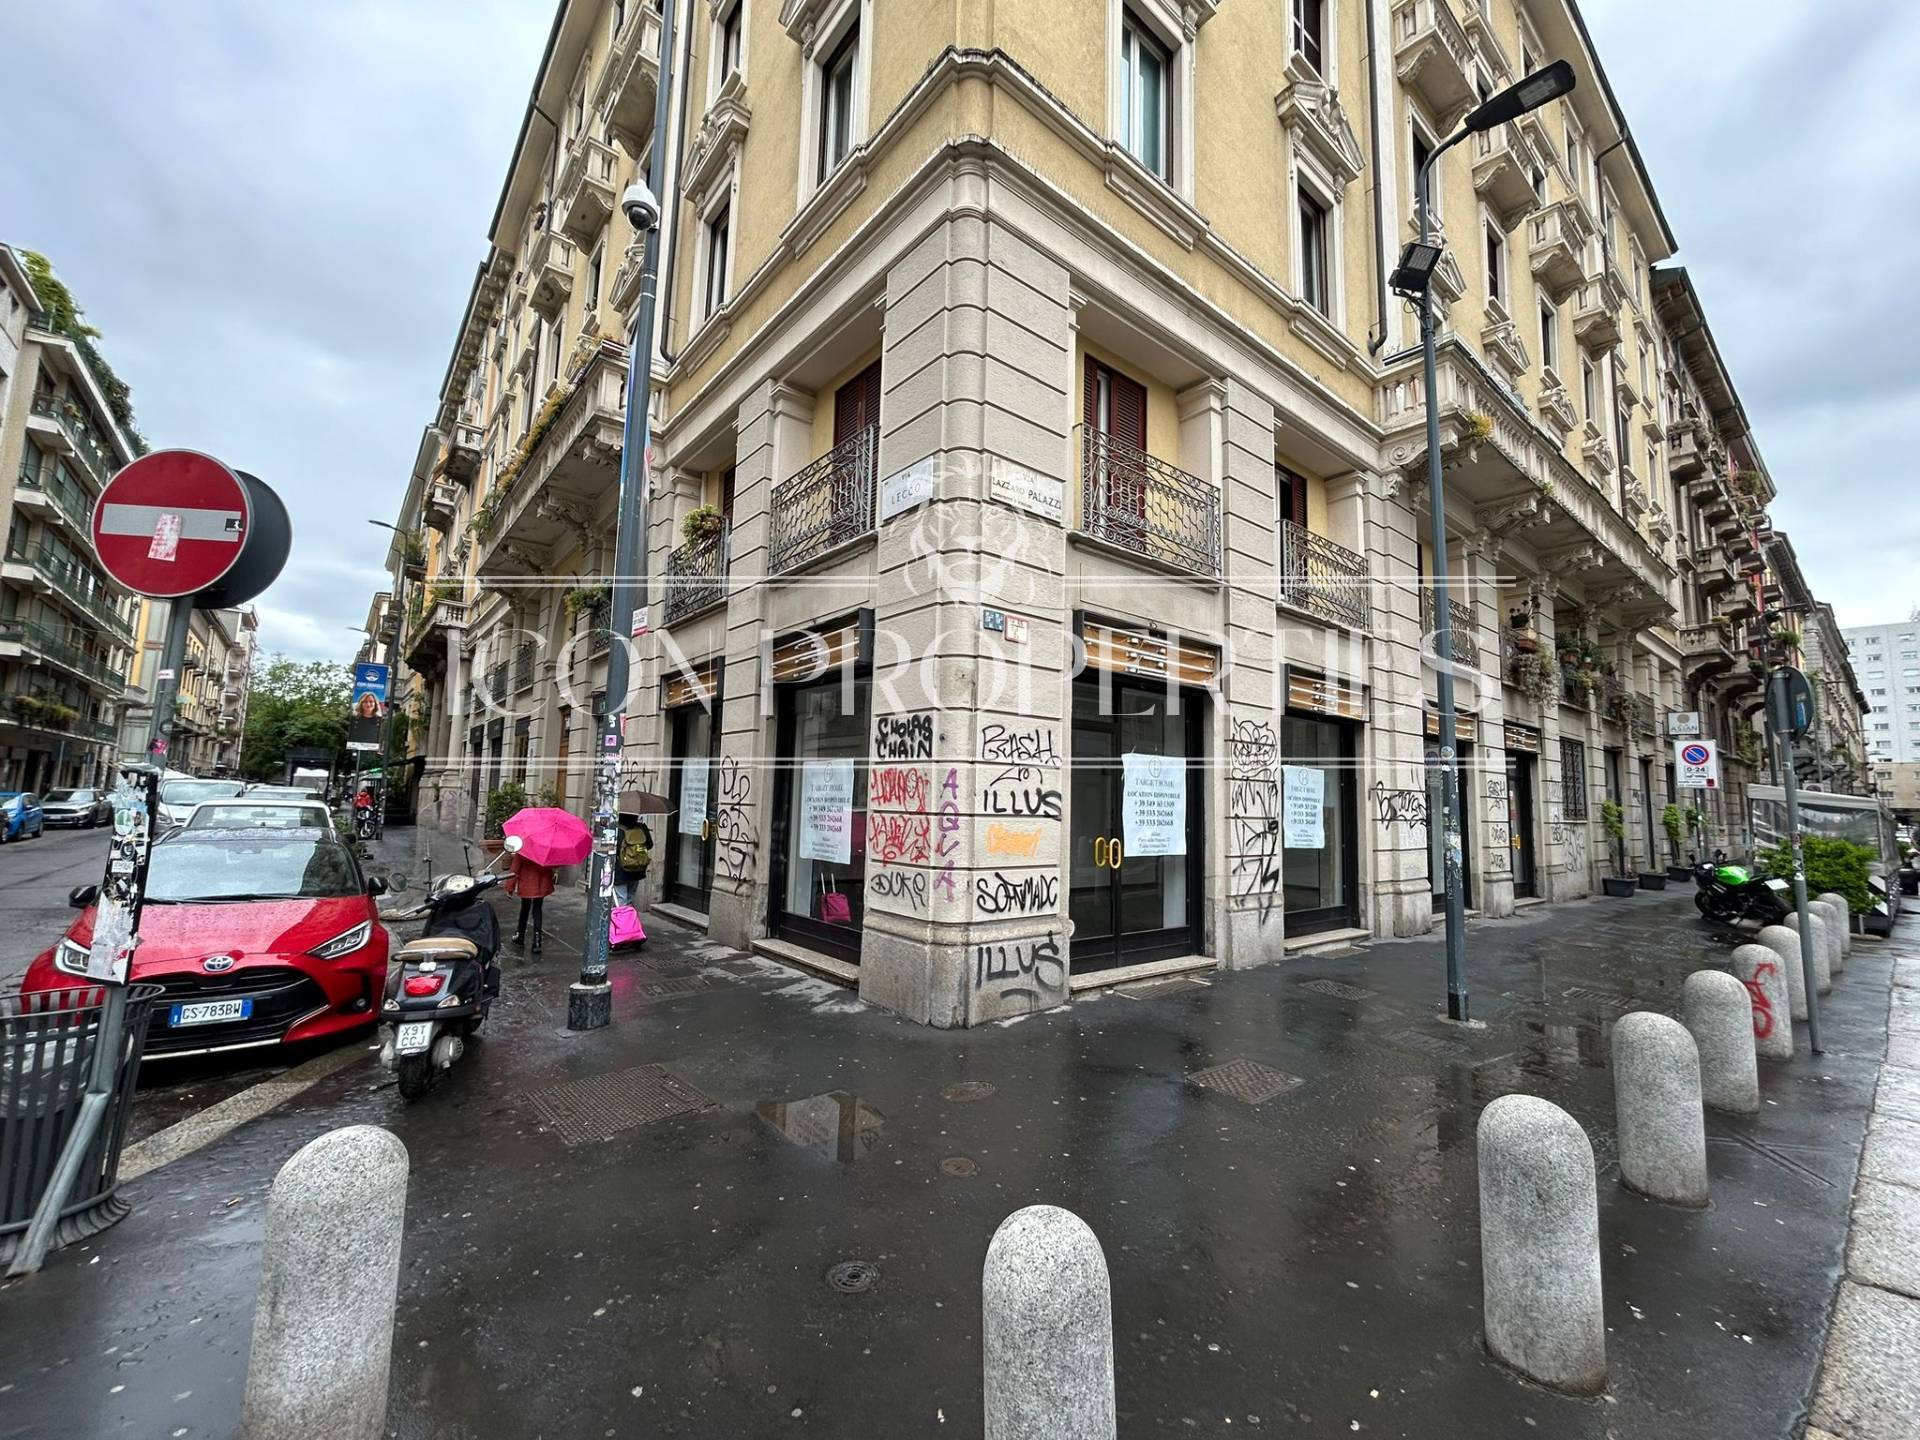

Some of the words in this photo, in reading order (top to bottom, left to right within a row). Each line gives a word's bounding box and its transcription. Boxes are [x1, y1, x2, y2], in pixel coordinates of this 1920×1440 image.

[891, 482, 921, 505] LECCO
[983, 788, 1062, 822] ILLUS
[975, 931, 1064, 992] ILLUS
